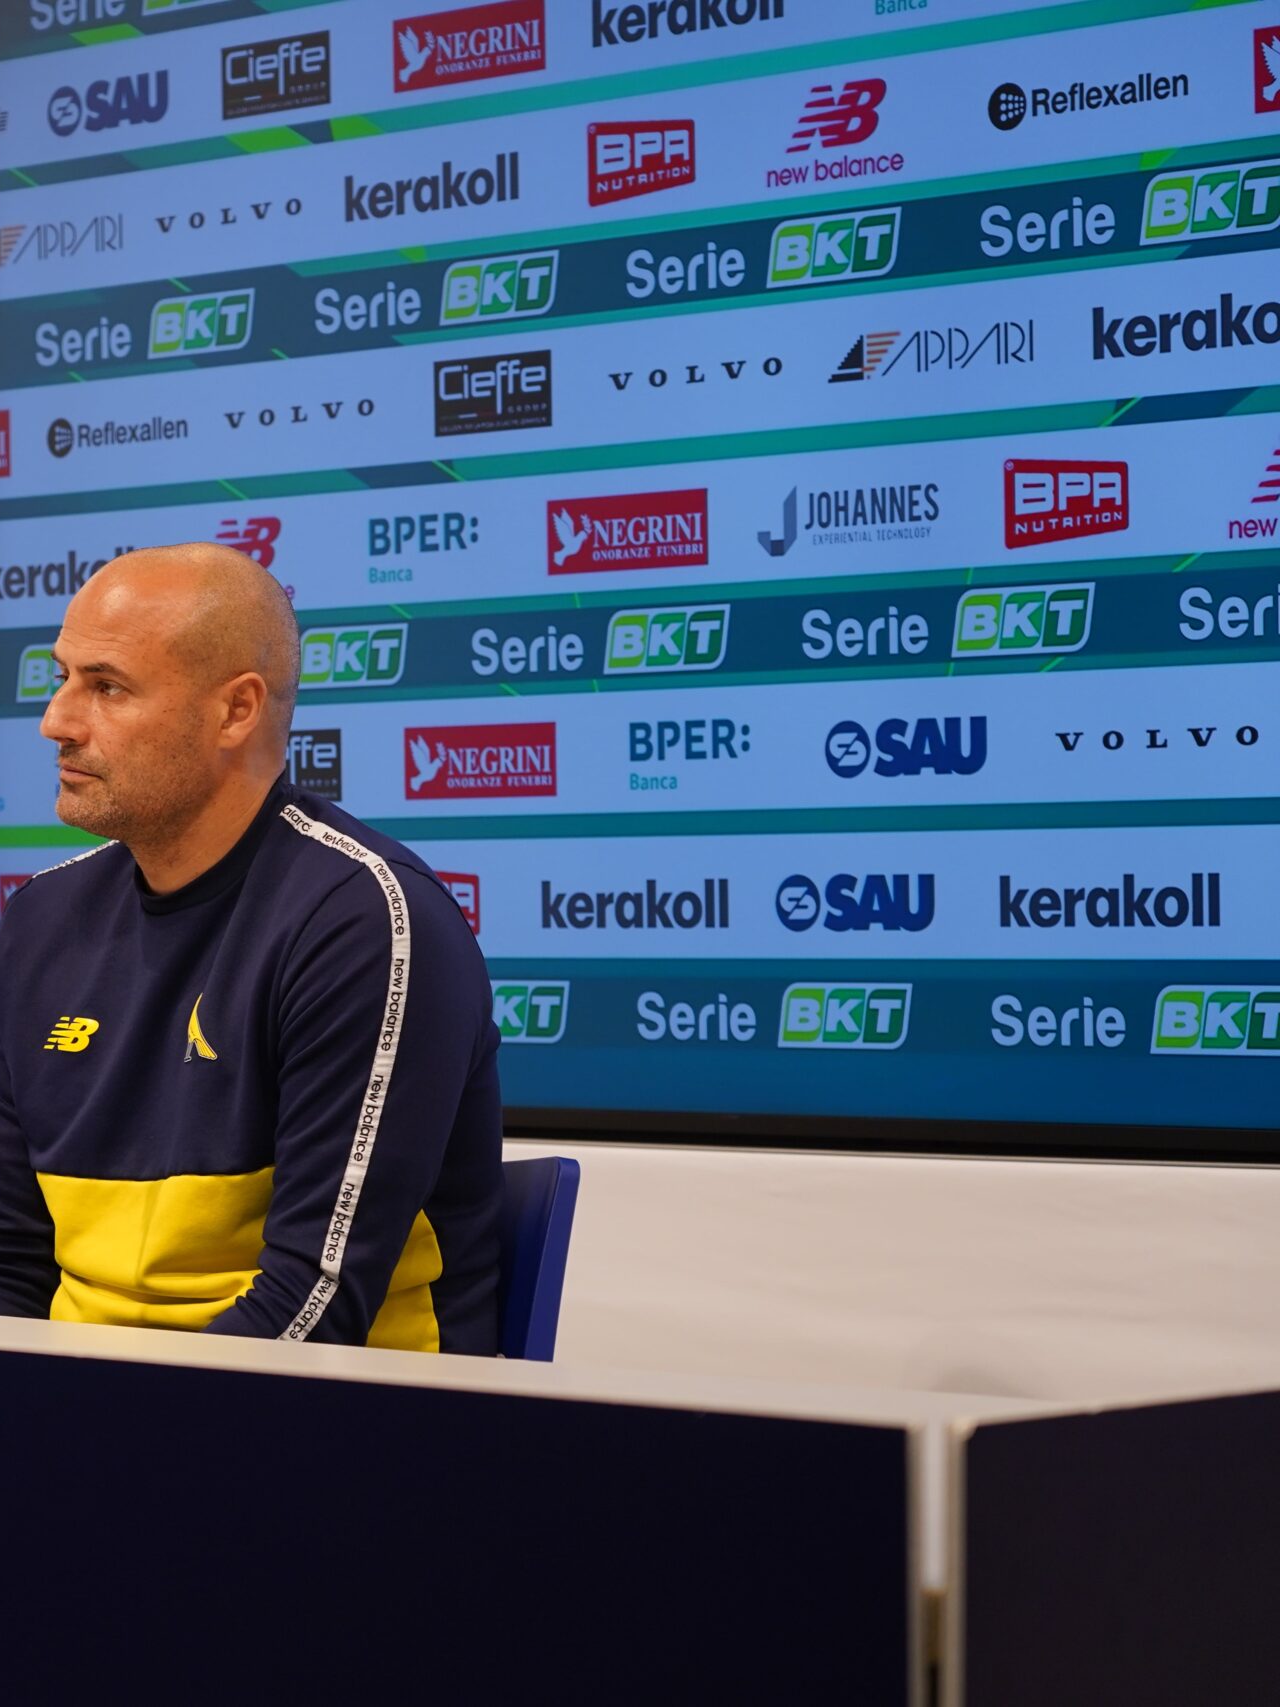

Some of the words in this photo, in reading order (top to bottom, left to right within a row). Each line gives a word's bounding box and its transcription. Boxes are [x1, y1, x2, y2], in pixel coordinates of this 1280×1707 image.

[435, 57, 490, 76] ONORANZE
[496, 50, 541, 67] FUNEBRI
[436, 19, 540, 62] NEGRINI
[225, 41, 326, 95] Cieffe
[84, 69, 169, 132] SAU
[1031, 72, 1189, 117] Reflexallen
[595, 129, 690, 176] BPA
[766, 165, 809, 188] new
[814, 153, 904, 182] balance
[345, 152, 520, 222] kerakoll
[596, 165, 690, 193] NUTRITION
[155, 198, 303, 234] VOLVO
[980, 197, 1115, 257] Serie
[1149, 176, 1280, 227] BKT
[626, 242, 745, 299] Serie
[775, 223, 891, 270] BKT
[315, 281, 421, 335] Serie
[448, 265, 551, 309] BKT
[35, 317, 131, 367] Serie
[155, 304, 247, 344] BKT
[439, 359, 546, 415] Cieffe
[609, 356, 783, 391] VOLVO
[77, 417, 188, 448] Reflexallen
[224, 398, 375, 430] VOLVO
[804, 483, 940, 530] JOHANNES
[1014, 472, 1122, 515] BPA
[593, 512, 703, 548] NEGRINI
[812, 529, 873, 545] EXPERIENTIAL
[876, 526, 932, 542] TECHNOLOGY
[1014, 511, 1123, 535] NUTRITION
[1228, 518, 1278, 539] new
[592, 547, 651, 561] ONORANZE
[656, 543, 703, 557] FUNEBRI
[369, 567, 413, 584] Banca
[801, 606, 929, 660] Serie
[959, 600, 1085, 641] BKT
[1179, 584, 1280, 640] Ser
[303, 638, 400, 674] BKT
[471, 626, 585, 676] Serie
[613, 619, 722, 653] BKT
[448, 745, 551, 775] NEGRINI
[873, 715, 988, 777] SAU
[1054, 725, 1260, 752] VOLVO
[447, 776, 502, 788] ONORANZE
[507, 775, 552, 787] FUNEBRI
[629, 773, 678, 791] Banca
[386, 884, 405, 936] balance
[541, 880, 729, 929] kerakoll
[823, 873, 936, 932] SAU
[999, 873, 1221, 928] kerakoll
[393, 958, 404, 989] new
[381, 991, 403, 1051] balance
[637, 991, 756, 1042] Serie
[788, 995, 903, 1033] BKT
[991, 995, 1126, 1048] Serie
[1161, 1001, 1280, 1038] BKT
[368, 1074, 384, 1102] new
[354, 1104, 378, 1161] balance
[339, 1182, 355, 1212] new
[326, 1212, 349, 1262] balance
